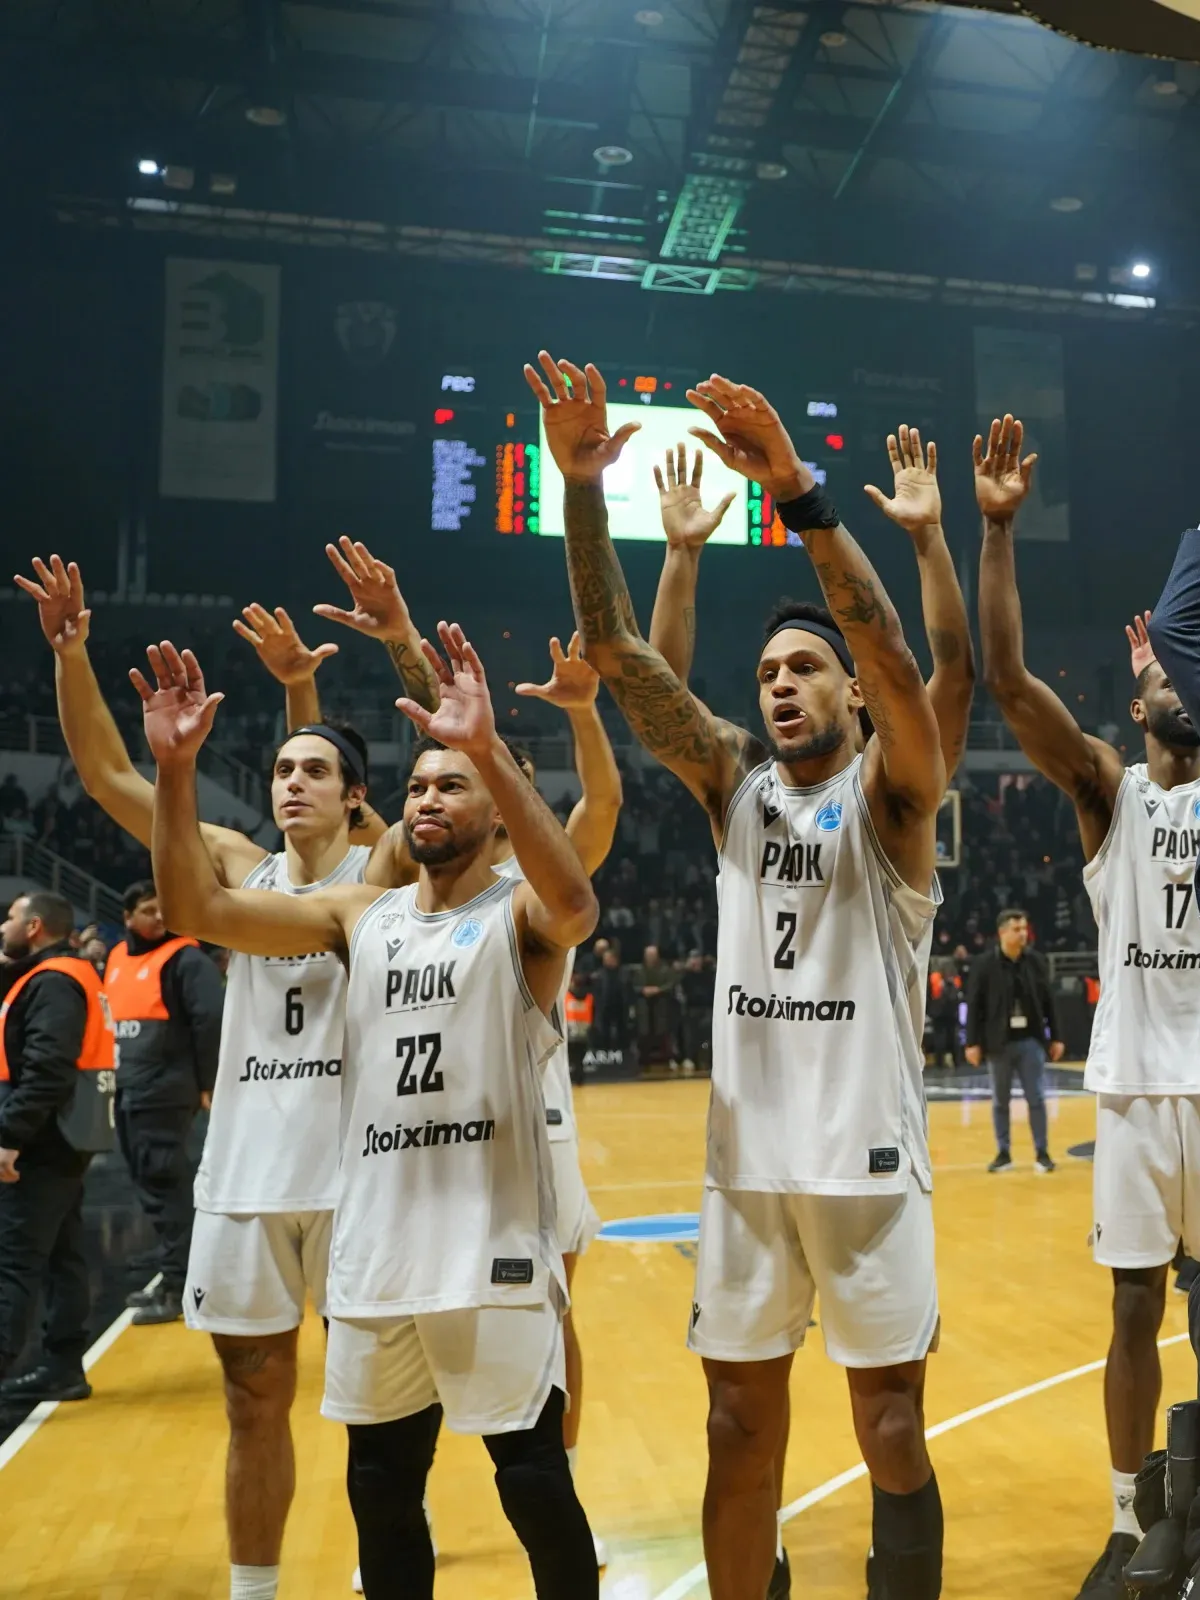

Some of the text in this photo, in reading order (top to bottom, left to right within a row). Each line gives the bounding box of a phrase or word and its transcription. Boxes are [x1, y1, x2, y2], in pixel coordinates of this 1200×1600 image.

[760, 841, 824, 882] PAOK
[1161, 883, 1193, 929] 17
[773, 911, 797, 970] 2
[385, 960, 457, 1008] PAOK
[727, 984, 856, 1021] Stoiximan
[285, 986, 304, 1036] 6
[239, 1056, 342, 1082] Stoixima
[396, 1032, 445, 1097] 22
